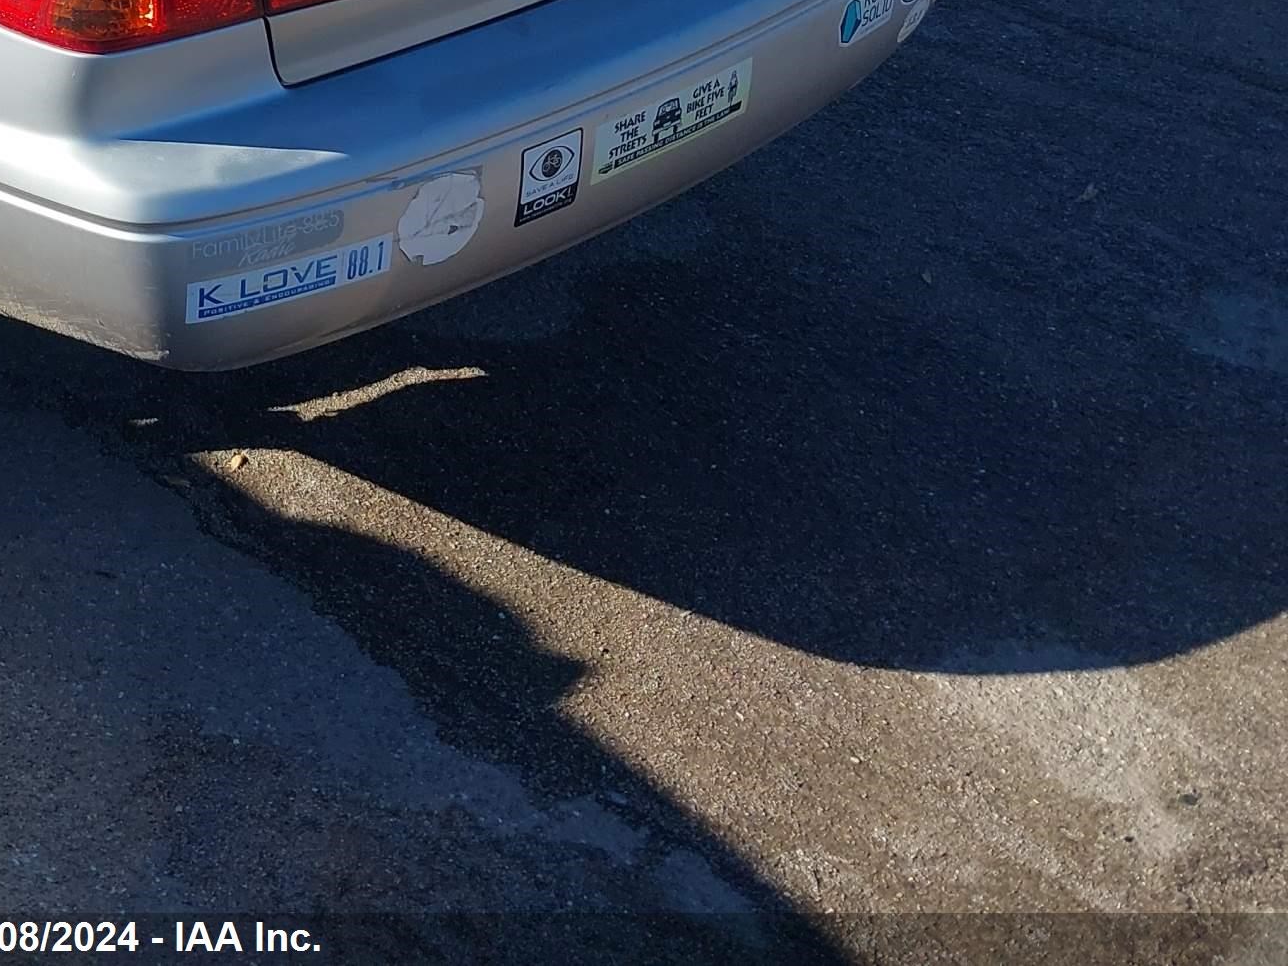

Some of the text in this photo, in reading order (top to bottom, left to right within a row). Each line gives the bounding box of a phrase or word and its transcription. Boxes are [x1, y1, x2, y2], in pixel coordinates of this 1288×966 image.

[686, 86, 726, 114] BIKE FIVE
[692, 78, 721, 99] GIVE A
[614, 110, 647, 134] SHARE
[694, 103, 715, 121] FEET
[608, 134, 648, 160] STREETS
[619, 126, 640, 143] THE
[523, 186, 575, 216] LOOK!
[198, 241, 385, 308] K LOVE 88.1
